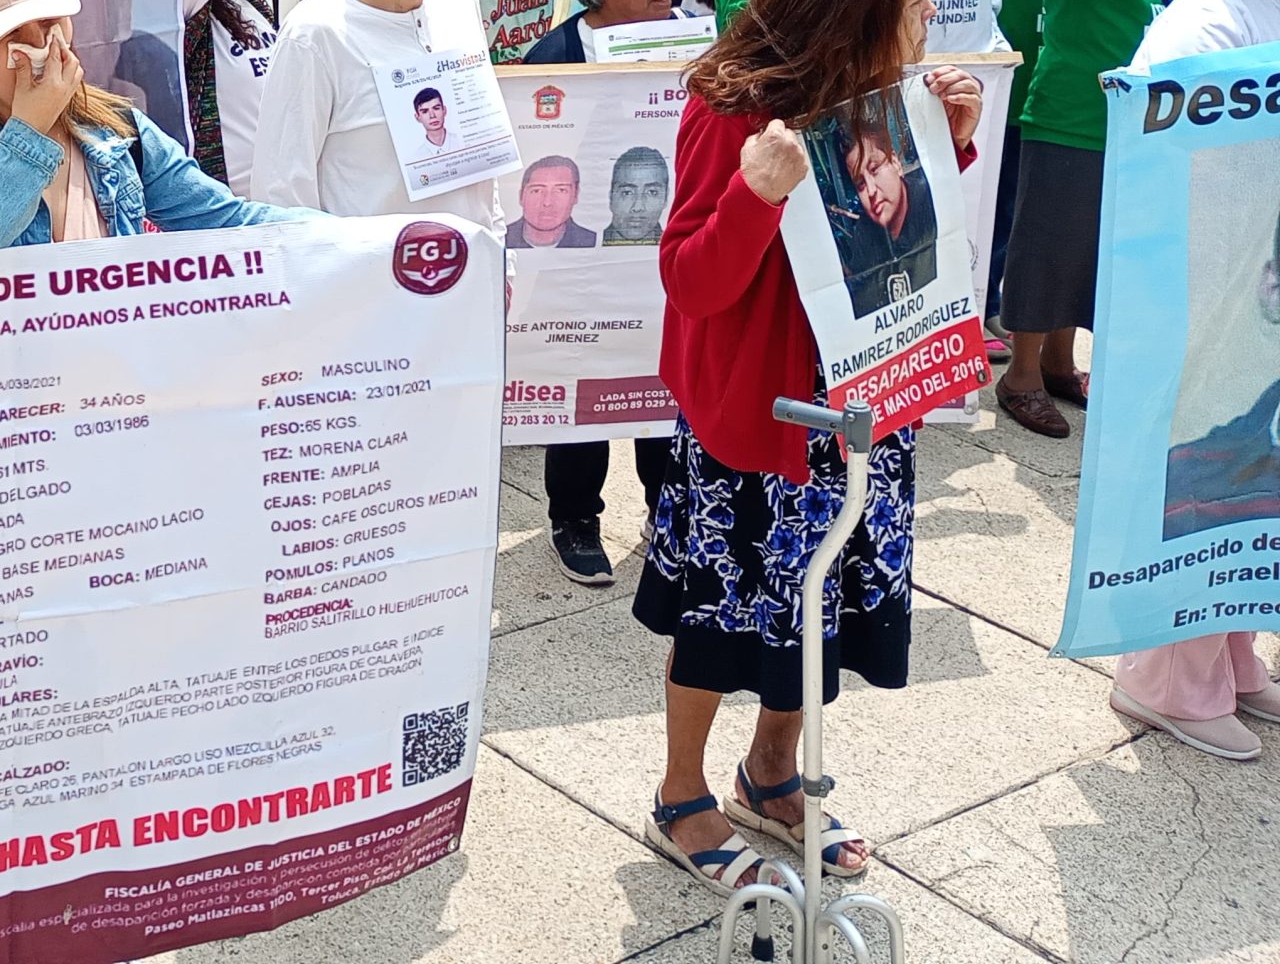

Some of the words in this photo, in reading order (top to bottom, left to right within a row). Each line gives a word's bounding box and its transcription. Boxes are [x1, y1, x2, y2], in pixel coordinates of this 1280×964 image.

[929, 13, 976, 26] FUNDEM
[634, 109, 680, 119] PERSONA
[401, 238, 458, 264] FGJ
[49, 253, 234, 296] URGENCIA
[22, 307, 129, 333] AYÚDANOS
[132, 306, 146, 321] A
[150, 291, 291, 319] ENCONTRARLA
[874, 293, 925, 334] ALVARO
[530, 321, 587, 332] ANTONIO
[590, 320, 643, 330] JIMENEZ
[544, 334, 600, 343] JIMENEZ
[831, 340, 893, 382] RAMIREZ
[896, 297, 972, 348] RODRIGUEZ
[261, 371, 303, 386] SEXO:
[321, 358, 410, 378] MASCULINO
[845, 334, 965, 403] DESAPARECIO
[600, 392, 626, 402] LADA
[628, 391, 642, 400] SIN
[884, 386, 922, 417] MAYO
[923, 372, 951, 398] DEL
[953, 356, 985, 382] 2016
[80, 396, 96, 410] 34
[100, 393, 146, 408] AÑOS
[274, 390, 356, 409] AUSENCIA:
[593, 402, 606, 412] 01
[608, 402, 626, 412] 800
[628, 401, 642, 410] 89
[644, 399, 666, 409] 029
[74, 415, 150, 437] 03/03/1986
[520, 414, 540, 425] 283
[542, 414, 556, 424] 20
[558, 414, 569, 424] 12
[1088, 538, 1244, 589] Desaparecido
[88, 572, 140, 588] BOCA:
[264, 621, 308, 640] BARRIO
[311, 606, 376, 630] SALITRILLO
[1173, 607, 1208, 628] En:
[133, 762, 393, 848] ENCONTRARTE
[104, 874, 172, 900] FISCALÍA
[176, 864, 241, 888] GENERAL
[267, 846, 326, 871] JUSTICIA
[328, 840, 353, 855] DEL
[356, 824, 405, 848] ESTADO
